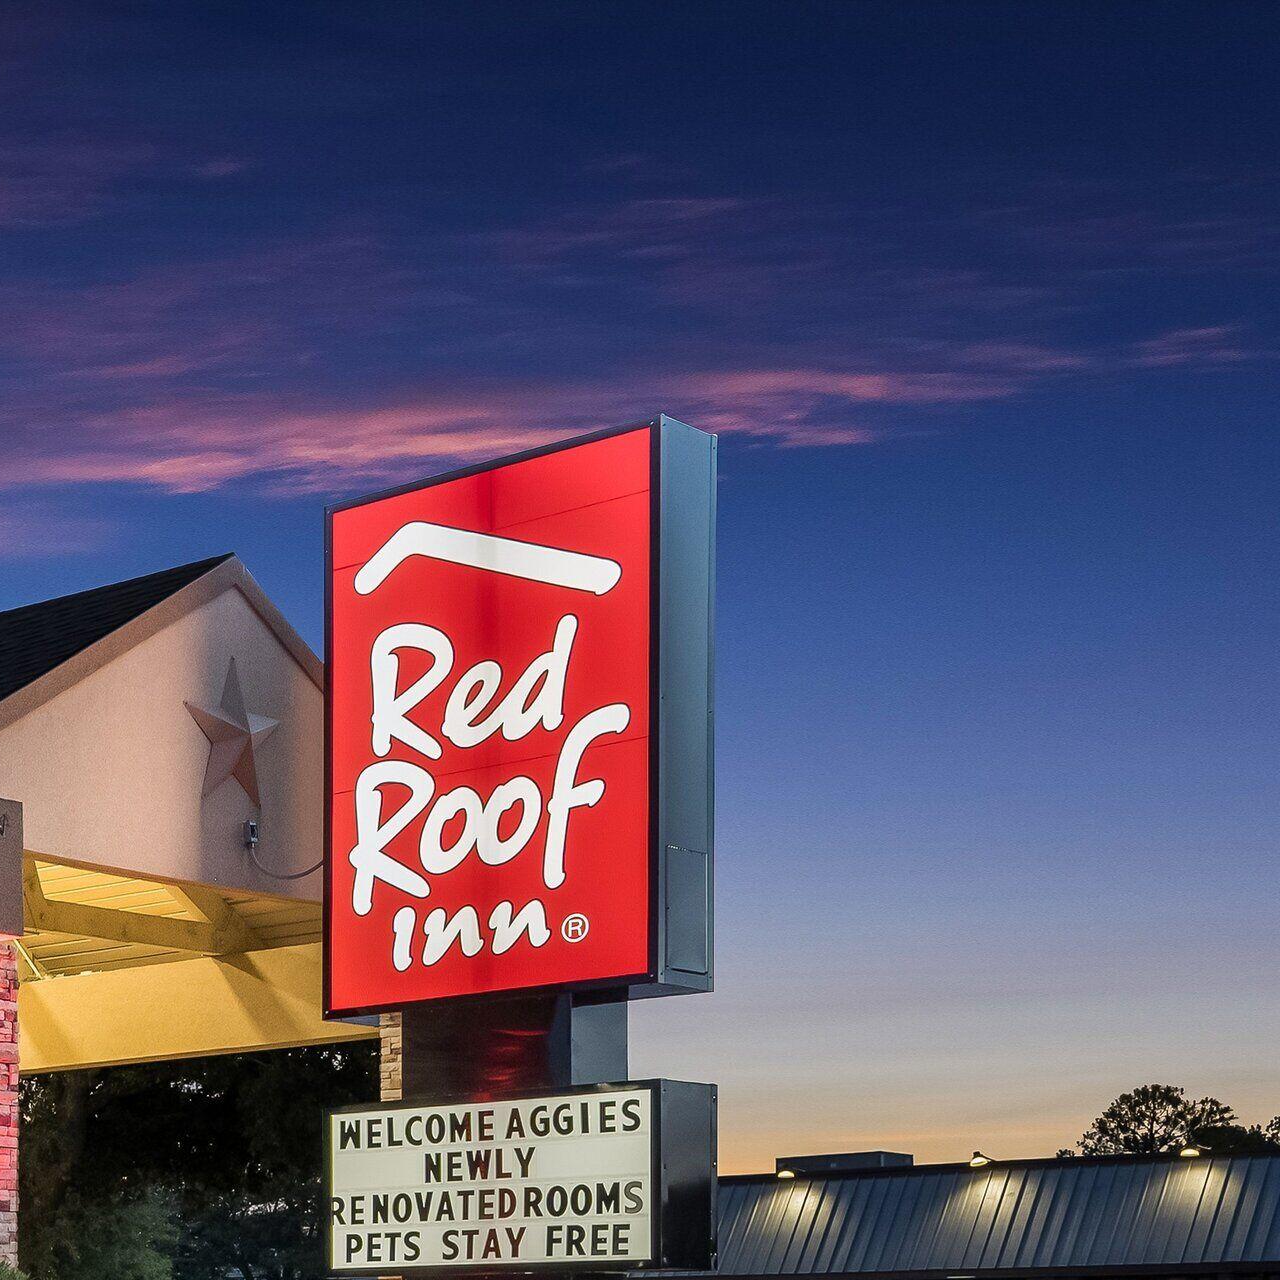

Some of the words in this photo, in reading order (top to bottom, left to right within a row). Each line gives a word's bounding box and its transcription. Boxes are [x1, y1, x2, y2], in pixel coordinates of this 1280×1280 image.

[371, 613, 578, 760] Red
[349, 703, 631, 916] Roof
[339, 1110, 494, 1150] WELCOME
[505, 1099, 641, 1139] AGGIES
[424, 1147, 536, 1183] NEWLY
[331, 1188, 517, 1225] RENOVATED
[523, 1180, 644, 1218] ROOMS
[346, 1231, 421, 1263] PETS
[442, 1226, 527, 1261] STAY
[545, 1223, 631, 1257] FREE
